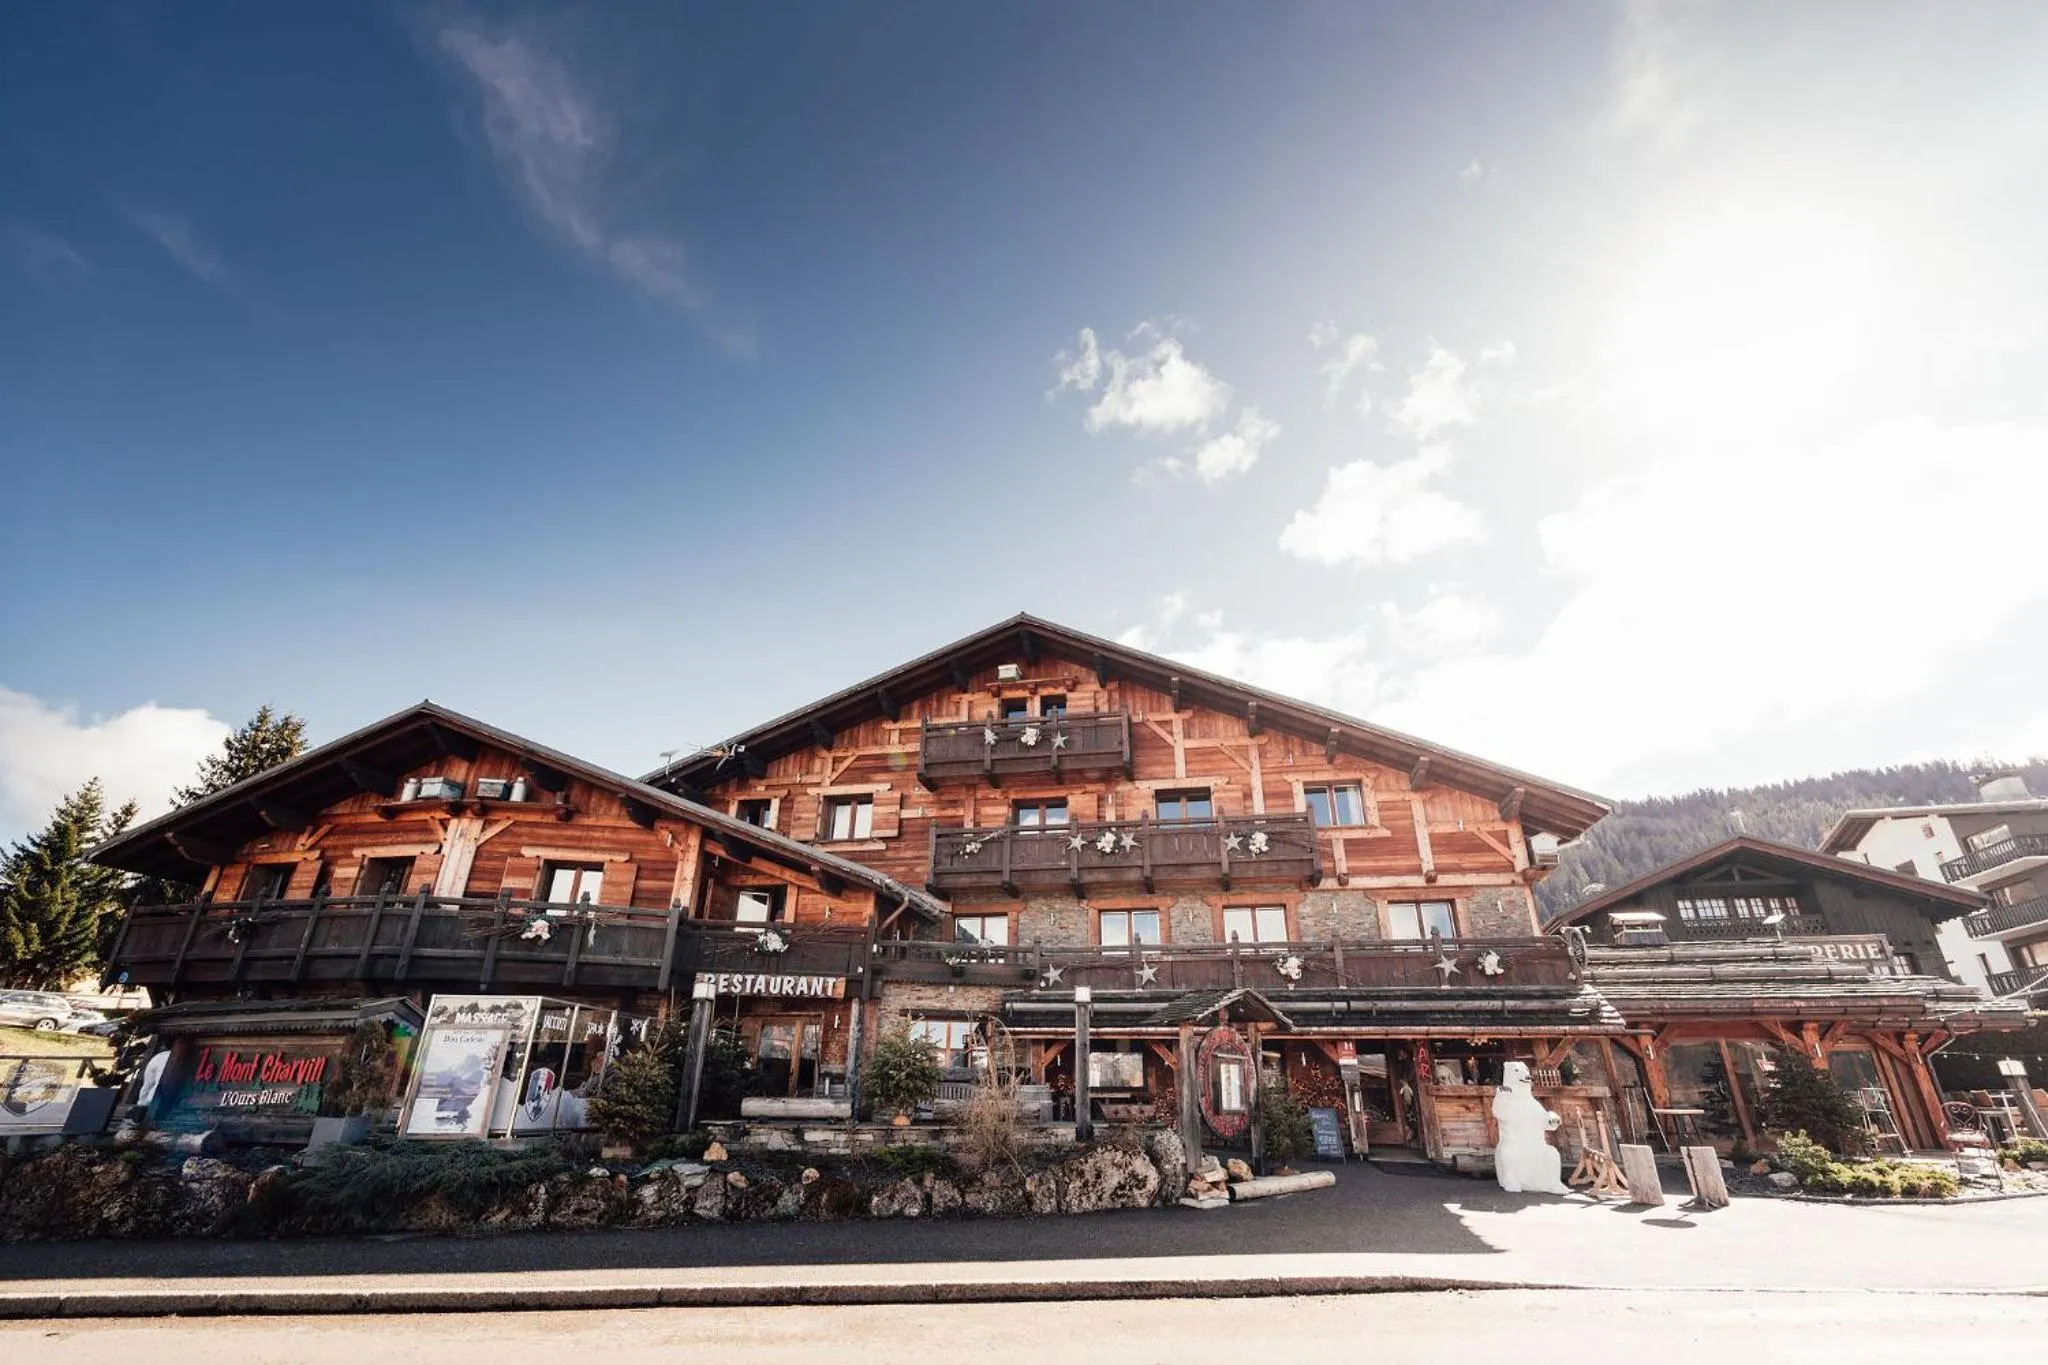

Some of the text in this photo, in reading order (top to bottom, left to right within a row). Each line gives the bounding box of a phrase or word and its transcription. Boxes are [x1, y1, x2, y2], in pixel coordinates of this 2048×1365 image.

[195, 1047, 327, 1087] Le Mont Charvin
[220, 1089, 294, 1107] L'Ours Blanc
